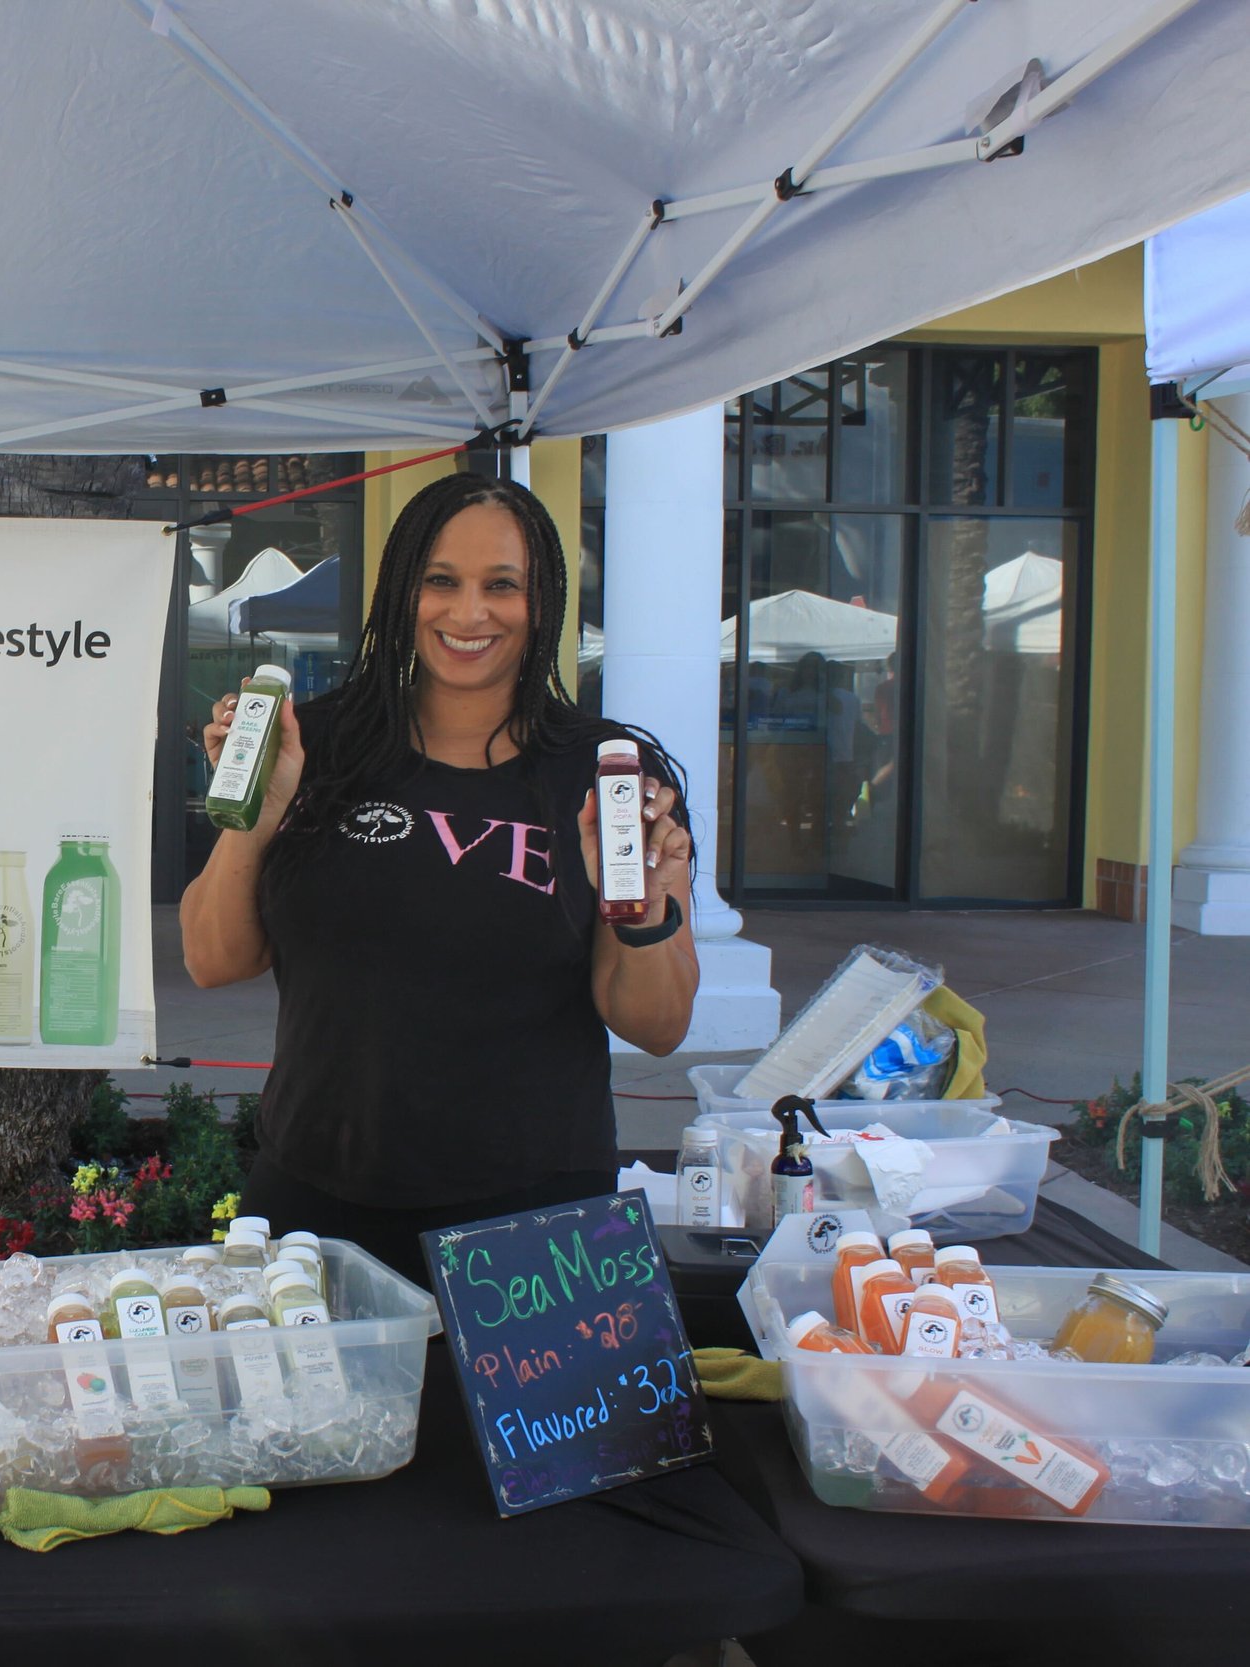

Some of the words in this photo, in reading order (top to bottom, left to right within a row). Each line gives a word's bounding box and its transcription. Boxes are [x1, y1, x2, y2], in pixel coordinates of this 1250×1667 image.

[467, 1246, 557, 1328] Sea
[548, 1230, 654, 1303] Moss
[475, 1344, 574, 1389] Plain:
[495, 1388, 619, 1459] Flavored:
